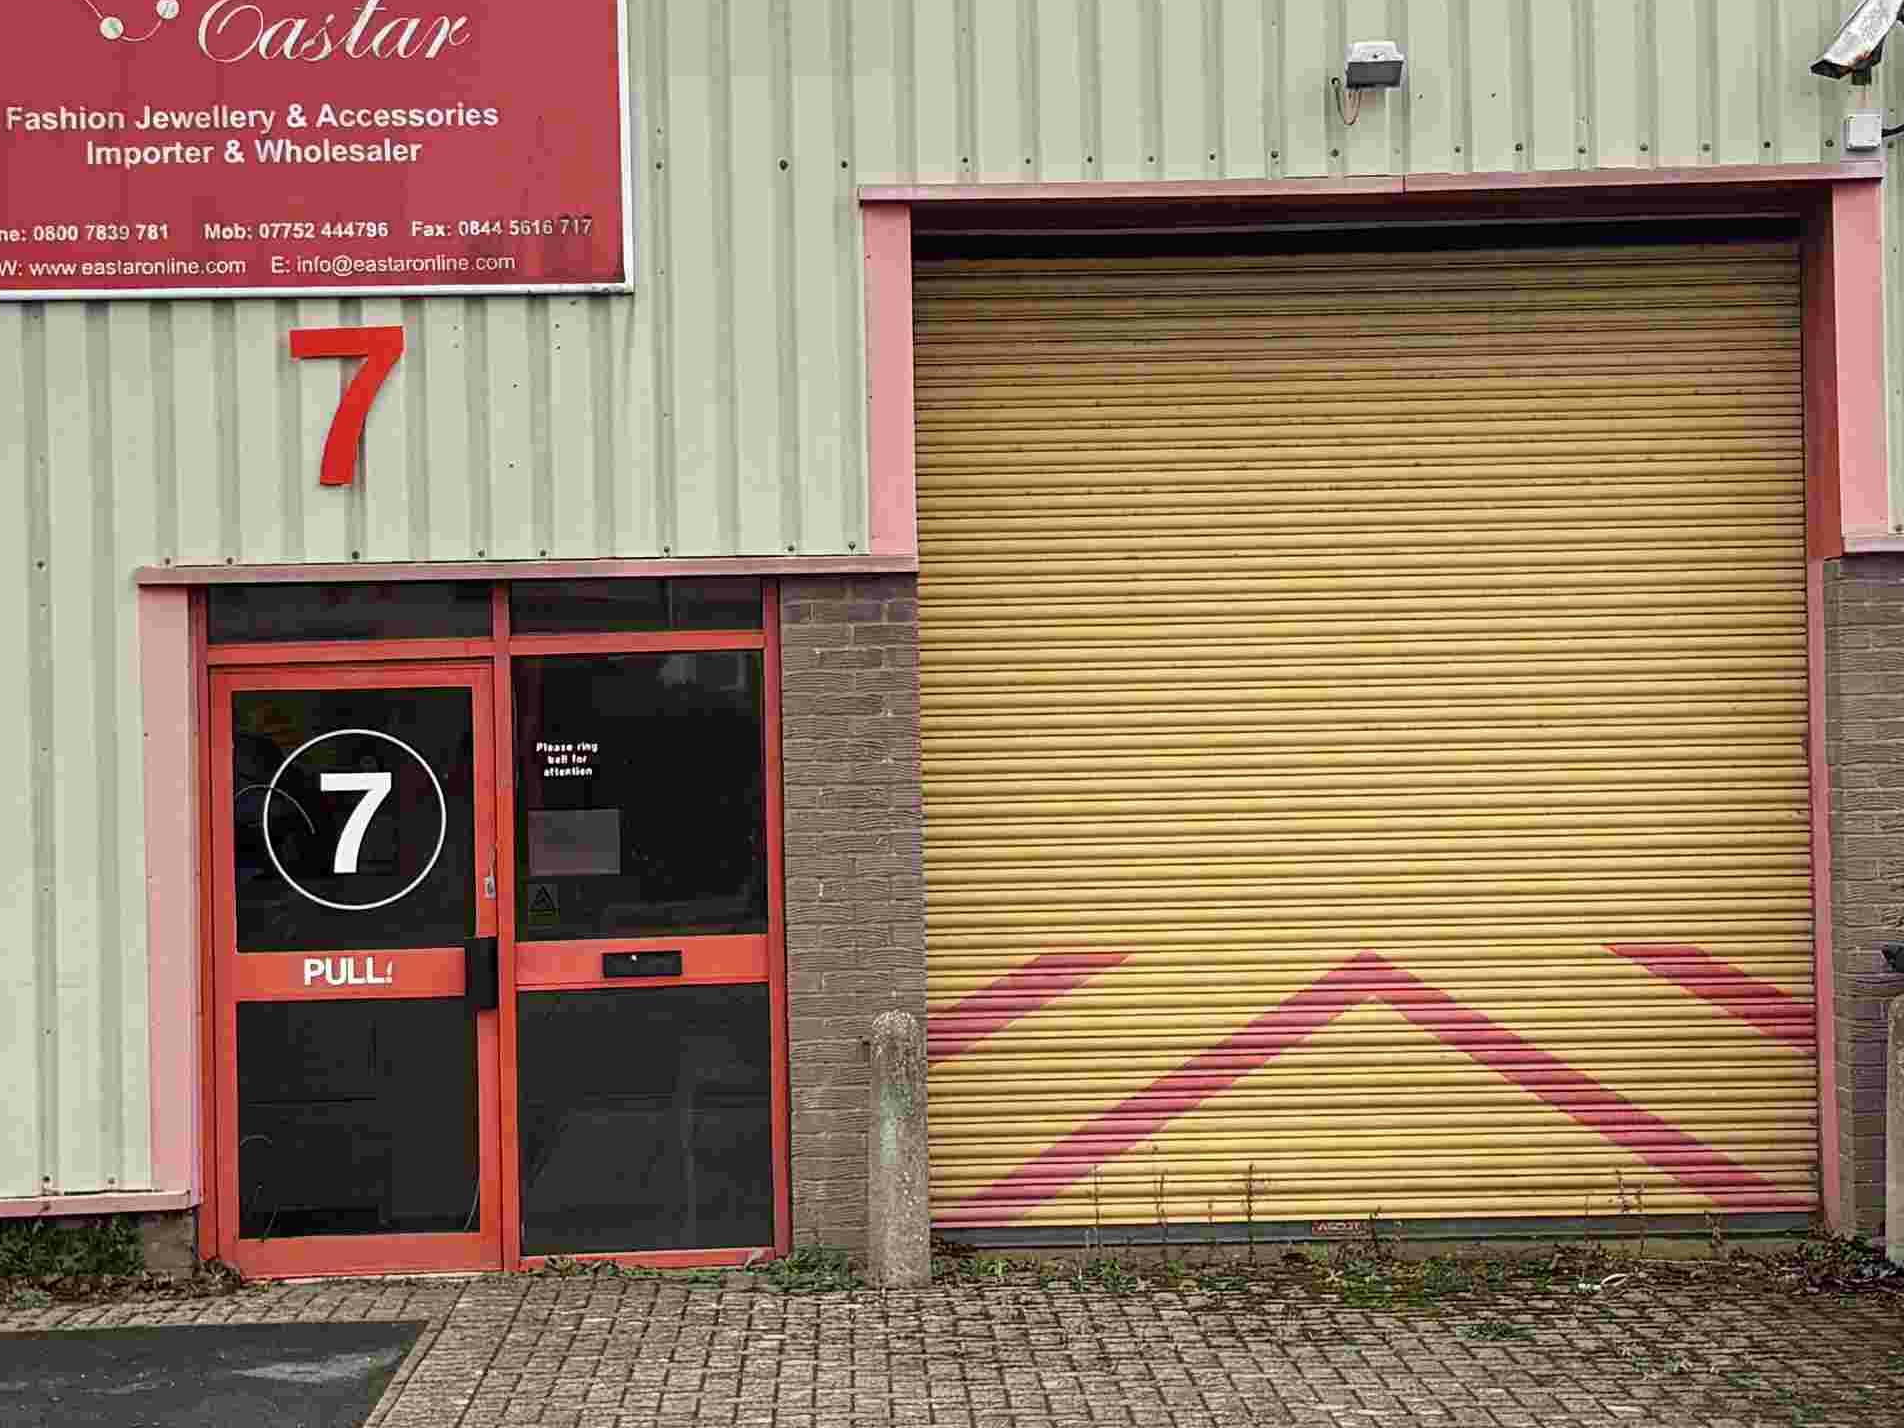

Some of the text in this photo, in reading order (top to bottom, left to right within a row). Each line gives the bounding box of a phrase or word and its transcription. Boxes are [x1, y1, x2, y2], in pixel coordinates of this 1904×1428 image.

[5, 102, 500, 135] Fashion Jewellery & Accessories
[86, 138, 423, 169] Importer & Wholesaler
[32, 224, 79, 242] 0800
[85, 223, 131, 241] 7839
[134, 223, 170, 241] 781
[204, 222, 253, 241] Mob:
[259, 222, 316, 239] 07752
[320, 221, 389, 238] 444796
[411, 220, 451, 237] Fax:
[458, 219, 503, 236] 0844
[508, 219, 553, 236] 5616
[559, 218, 593, 236] 717
[271, 256, 291, 274] E:
[296, 254, 516, 277] info@eastaronline.com
[289, 325, 405, 486] 7
[536, 741, 598, 754] Please ring
[547, 753, 588, 765] bell for
[543, 766, 593, 777] attention
[320, 772, 392, 873] 7
[303, 956, 394, 987] PULL!
